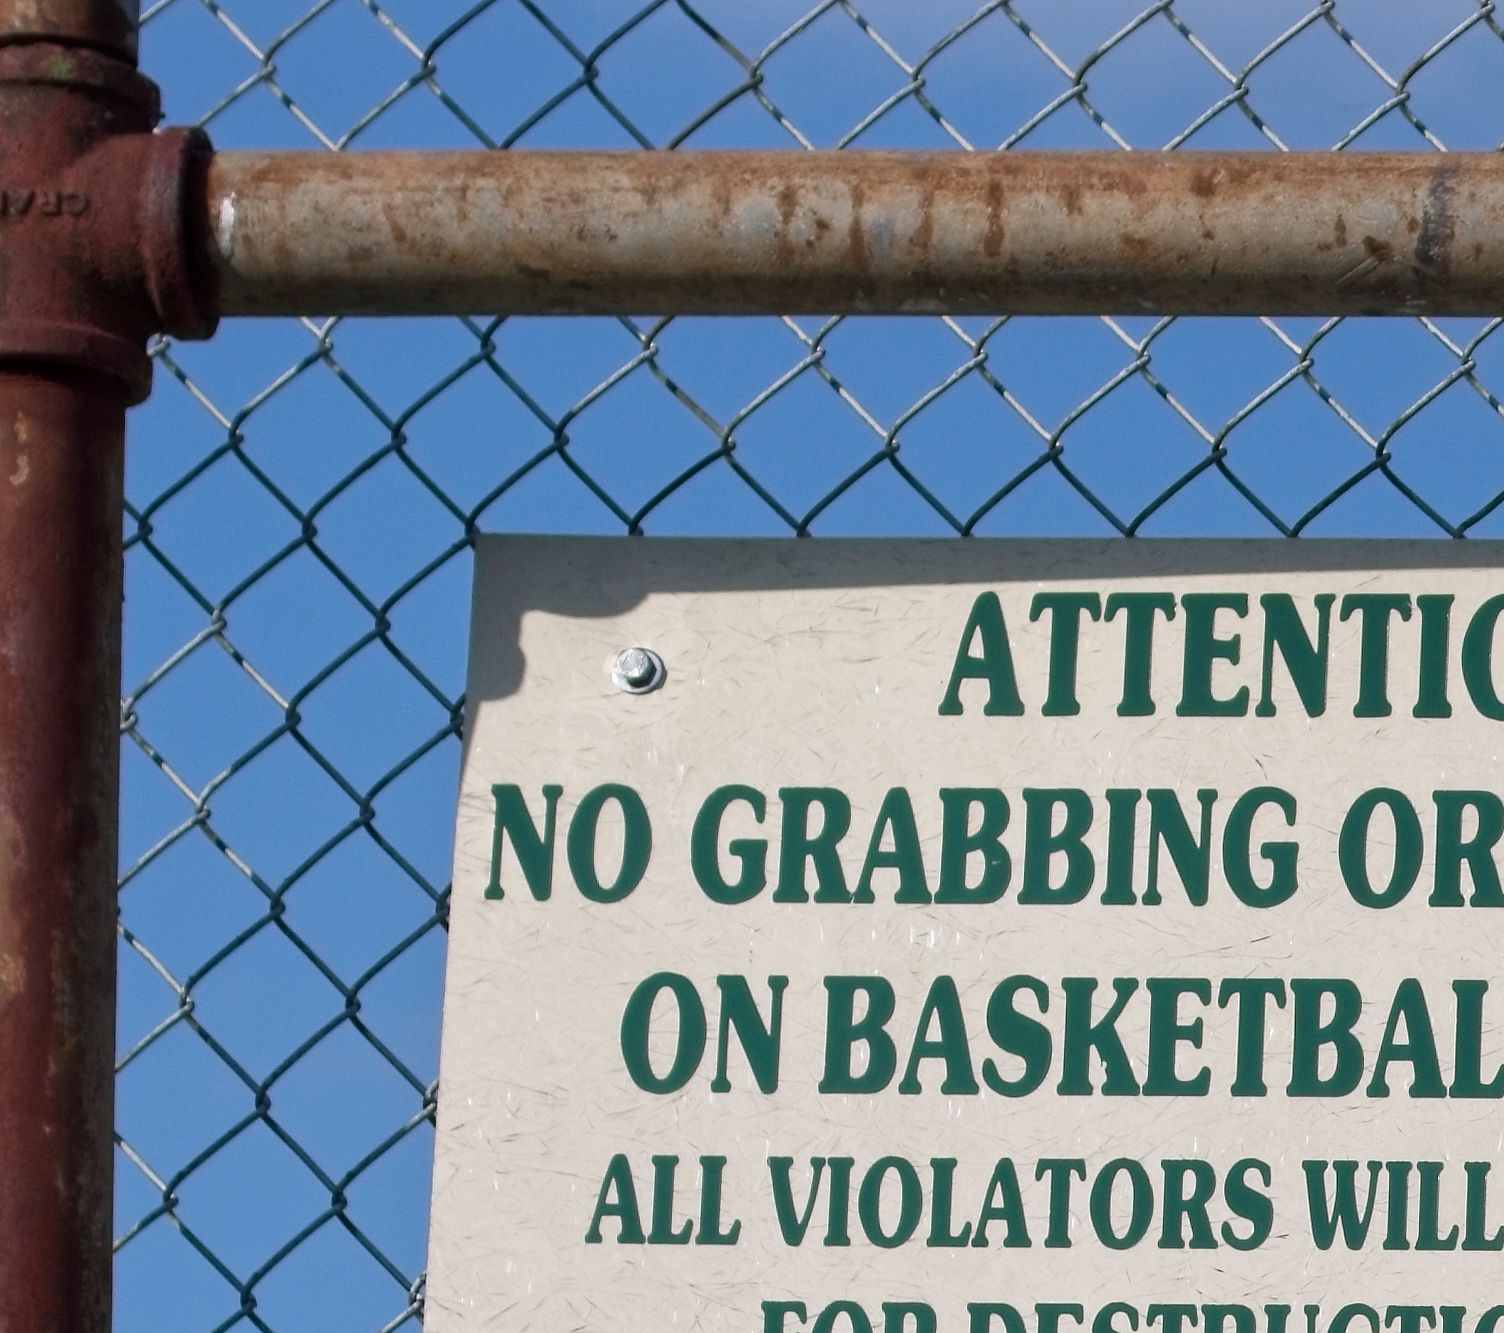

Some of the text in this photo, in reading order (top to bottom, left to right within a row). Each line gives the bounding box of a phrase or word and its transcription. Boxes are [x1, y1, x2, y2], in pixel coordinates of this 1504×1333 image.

[483, 782, 652, 904] NO
[689, 783, 1299, 908] GRABBING
[619, 970, 789, 1095] ON
[585, 1154, 741, 1246] ALL
[767, 1155, 1274, 1251] VIOLATORS
